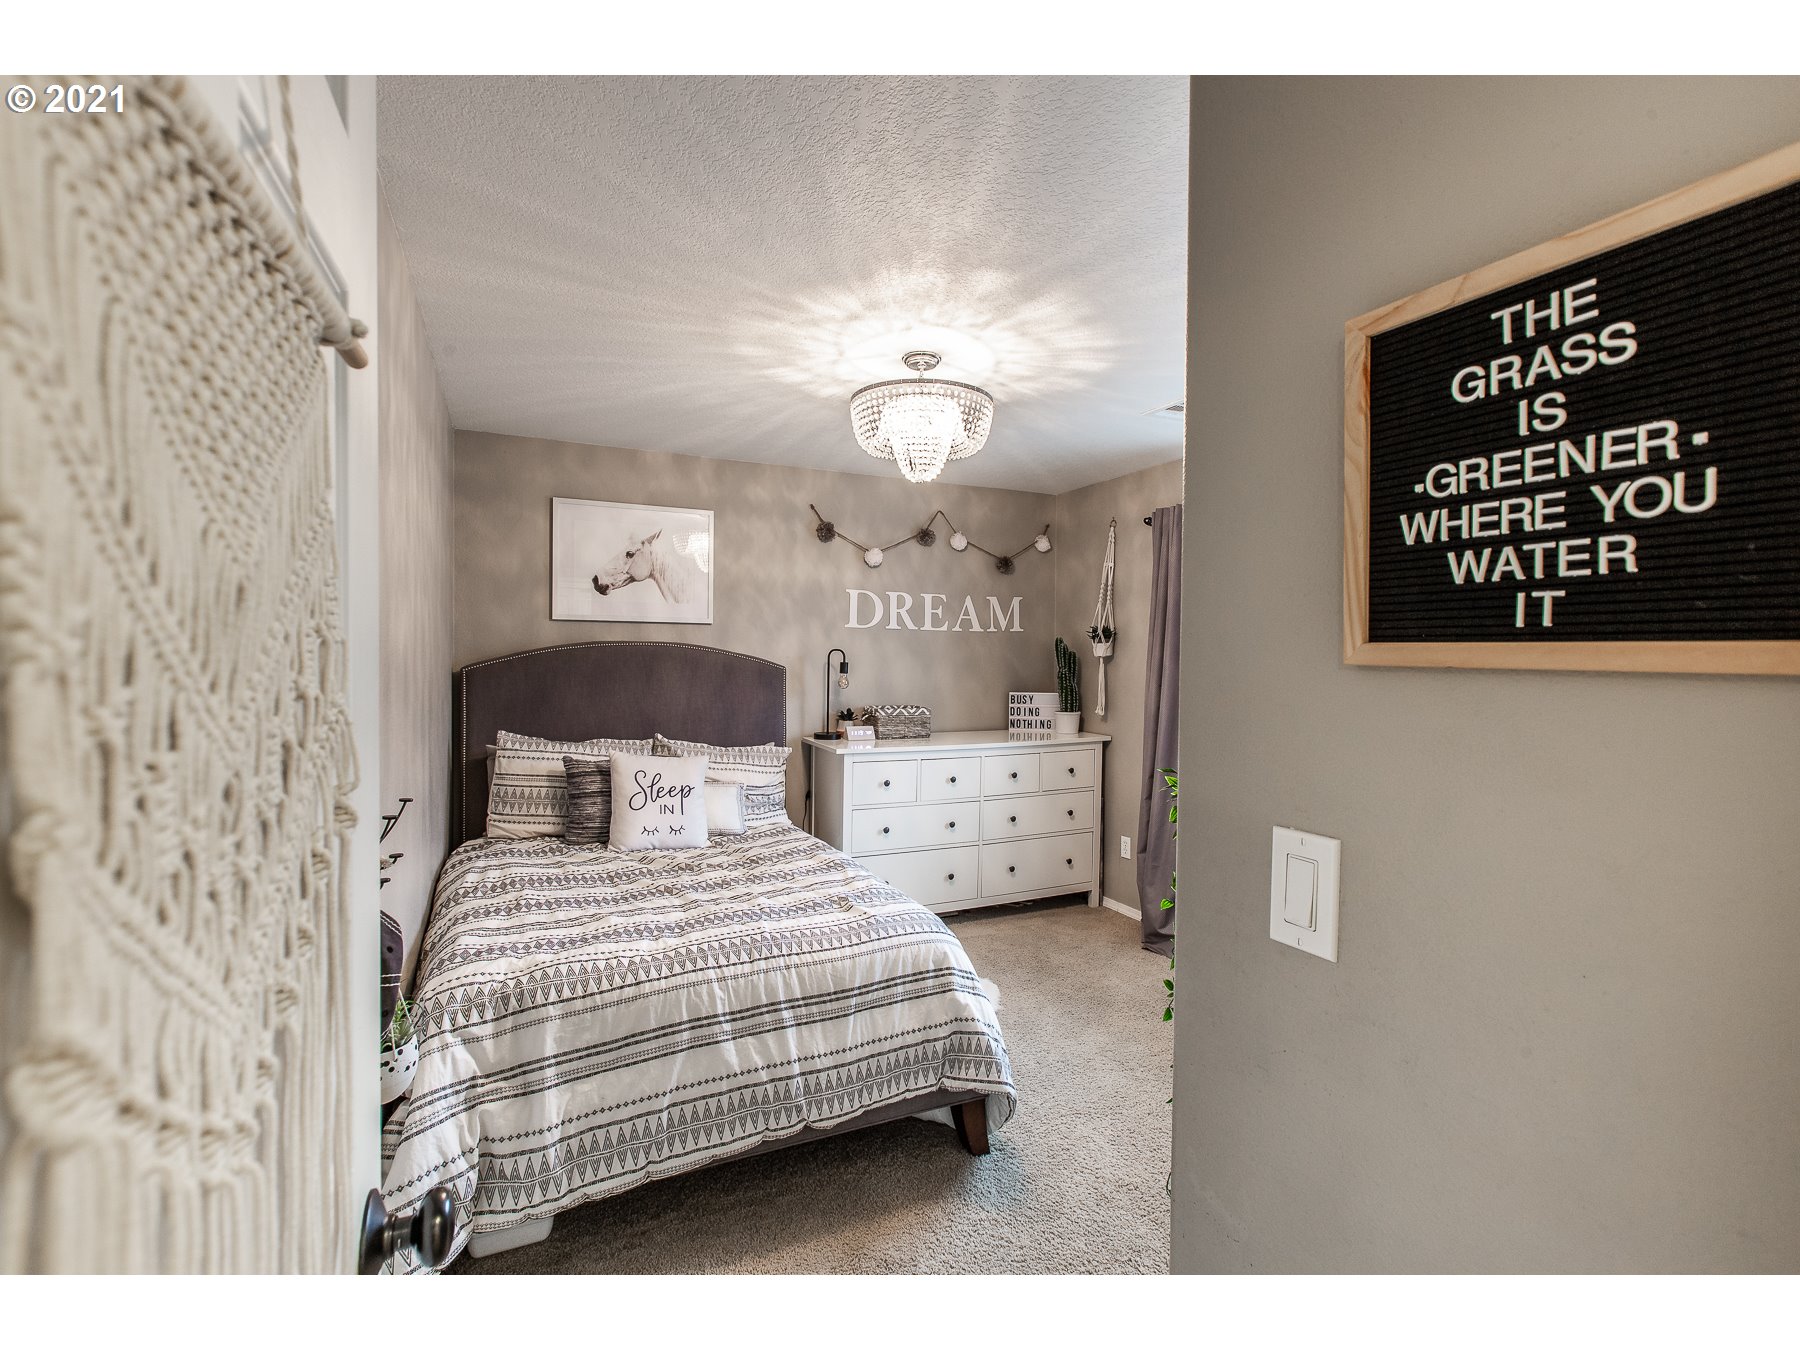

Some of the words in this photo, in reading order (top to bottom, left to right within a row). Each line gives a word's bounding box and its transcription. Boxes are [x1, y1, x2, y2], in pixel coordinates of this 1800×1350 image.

[1491, 278, 1599, 345] THE
[1451, 321, 1638, 403] GRASS
[1518, 391, 1567, 436] IS
[1400, 491, 1567, 545] WHERE
[1590, 466, 1718, 523] YOU
[1447, 534, 1639, 585] WATER
[845, 588, 1024, 632] DREAM
[1515, 590, 1566, 628] IT
[1009, 706, 1040, 717] DOING
[1010, 694, 1034, 705] BUSY
[1009, 719, 1052, 730] NOTHING
[629, 770, 695, 815] Sleep
[659, 804, 675, 815] IN
